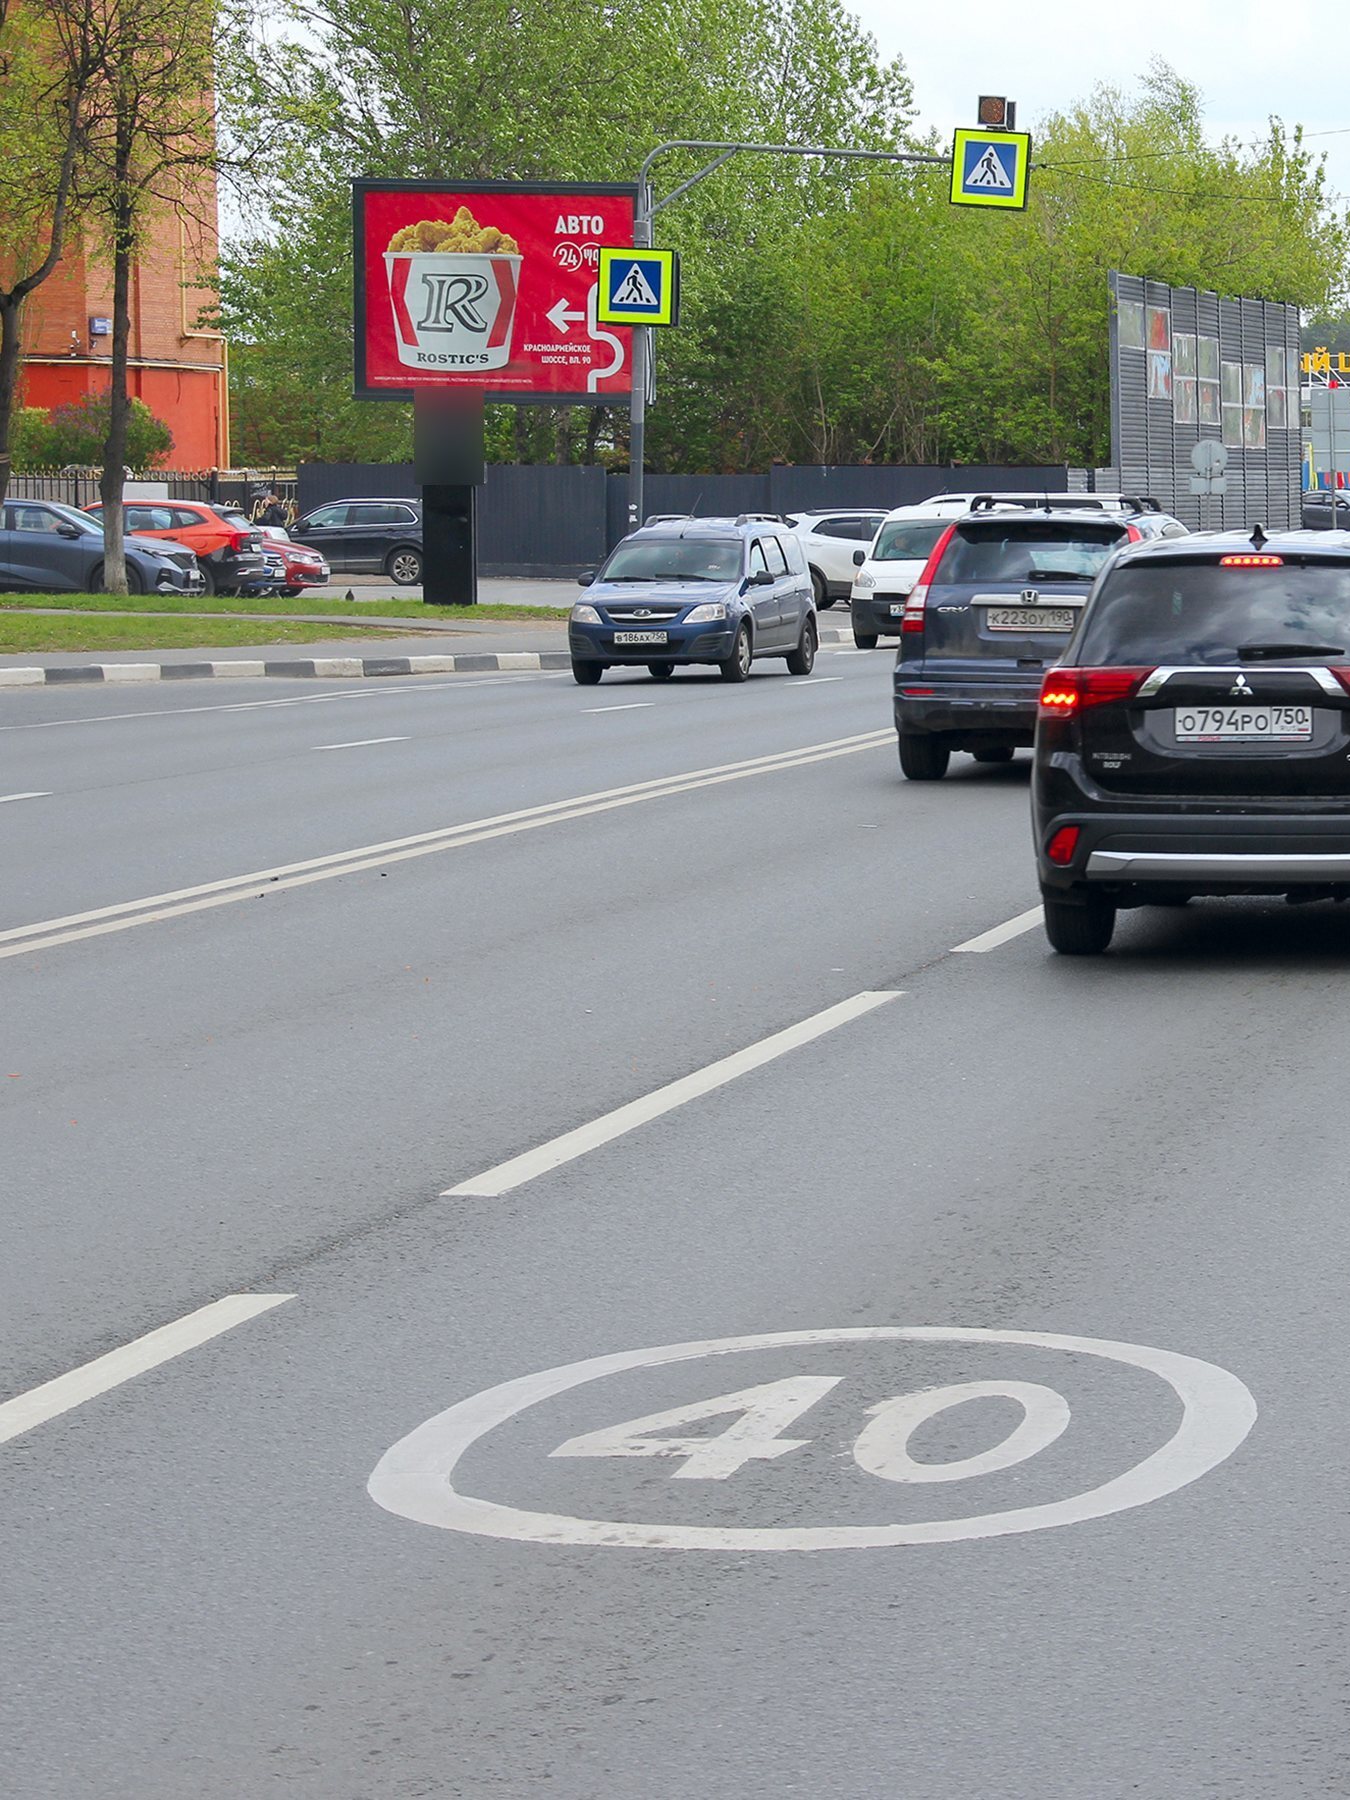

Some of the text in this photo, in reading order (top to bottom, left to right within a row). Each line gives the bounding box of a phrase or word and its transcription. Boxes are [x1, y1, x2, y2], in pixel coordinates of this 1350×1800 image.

[554, 215, 604, 235] АВТО
[558, 247, 578, 266] 24
[523, 342, 591, 353] КРАСНОАРМЕЙСКОЕ
[416, 352, 489, 365] ROSTIC'S
[541, 355, 568, 365] ШОССЕ,
[582, 356, 591, 364] 90
[1182, 708, 1306, 731] О794РО 750
[546, 1375, 1072, 1483] 40
